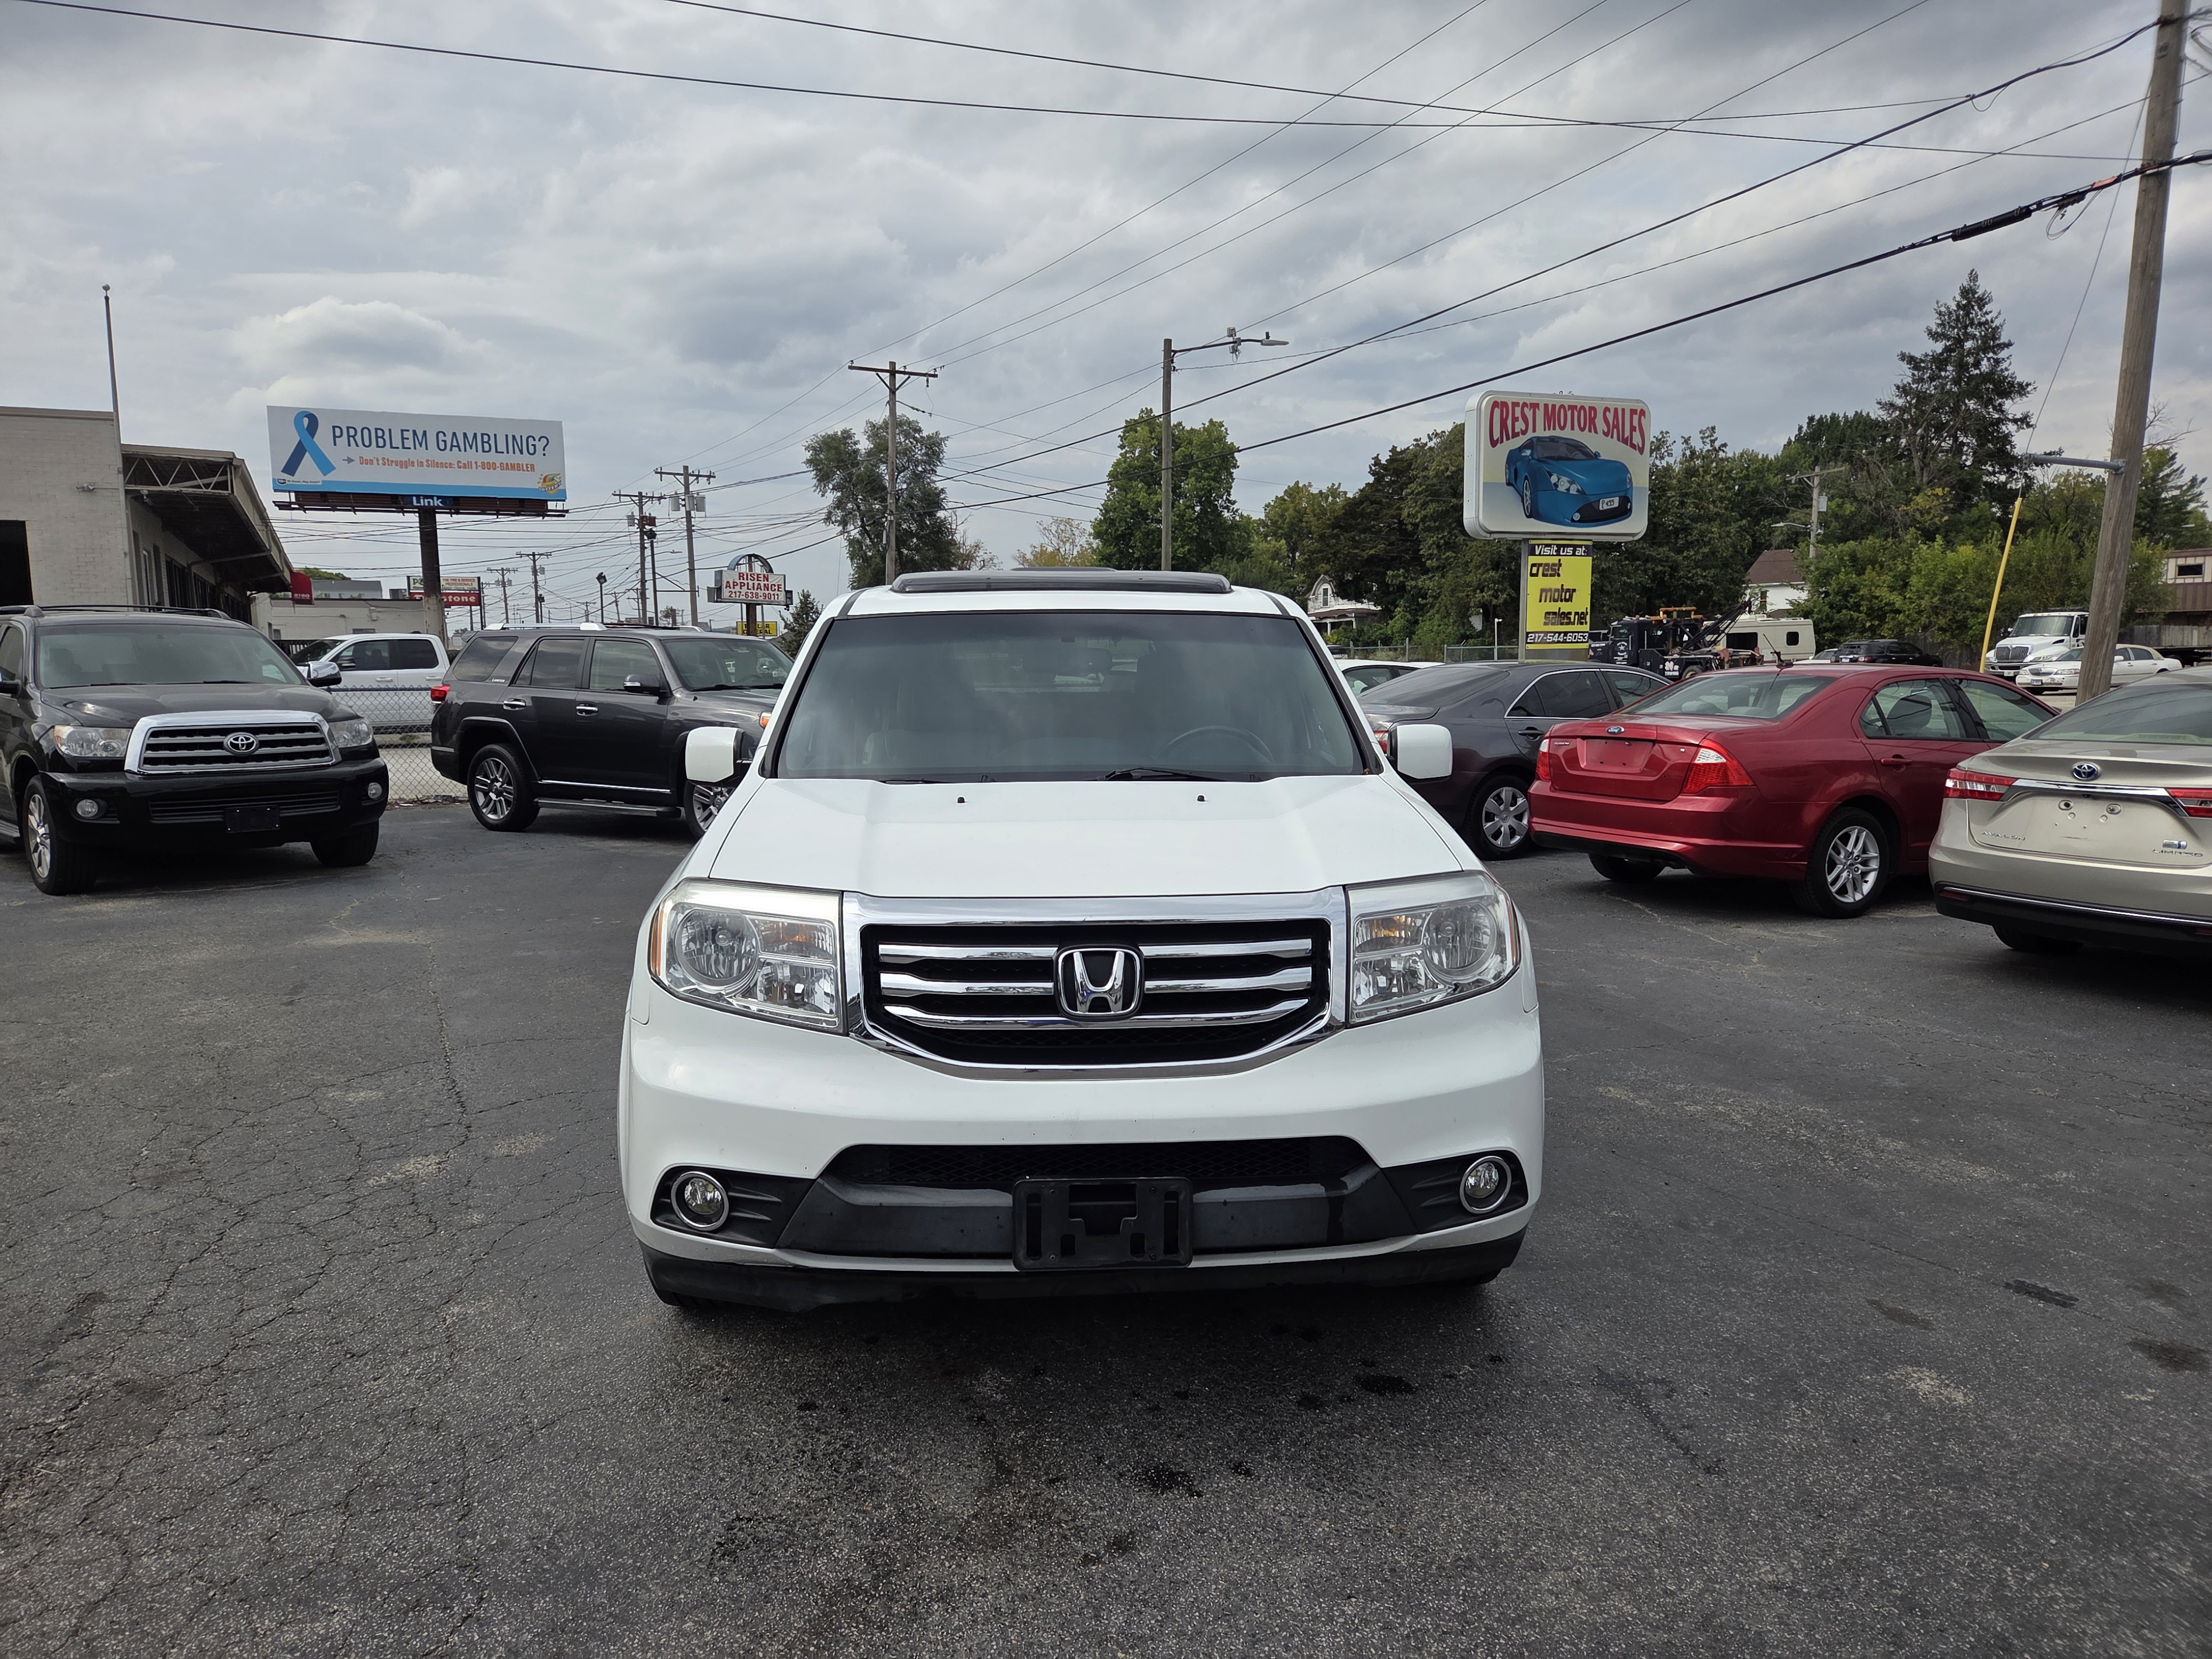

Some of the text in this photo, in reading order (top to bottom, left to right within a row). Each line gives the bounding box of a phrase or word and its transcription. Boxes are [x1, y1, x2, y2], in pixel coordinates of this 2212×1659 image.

[1489, 400, 1646, 456] CREST MOTOR SALES
[332, 425, 549, 457] PROBLEM GAMBLING?
[359, 456, 380, 466] Don't
[382, 457, 415, 469] Struggle
[425, 458, 455, 469] Silence:
[457, 460, 473, 469] Call
[474, 461, 535, 472] 1-800-GAMBLER
[539, 480, 562, 492] LOTTERY
[413, 496, 444, 506] Link
[1535, 545, 1557, 555] Visit
[1575, 546, 1587, 555] at:
[1530, 559, 1562, 577] crest
[738, 572, 769, 582] RISEN
[725, 581, 782, 592] APPLIANCE
[728, 591, 779, 600] 217-638-9011
[1538, 584, 1576, 603] motor
[1543, 607, 1588, 625] sales.net
[1527, 633, 1589, 642] 217-544-6053
[1981, 831, 2025, 841] AVALON
[2152, 848, 2203, 857] LIMITED
